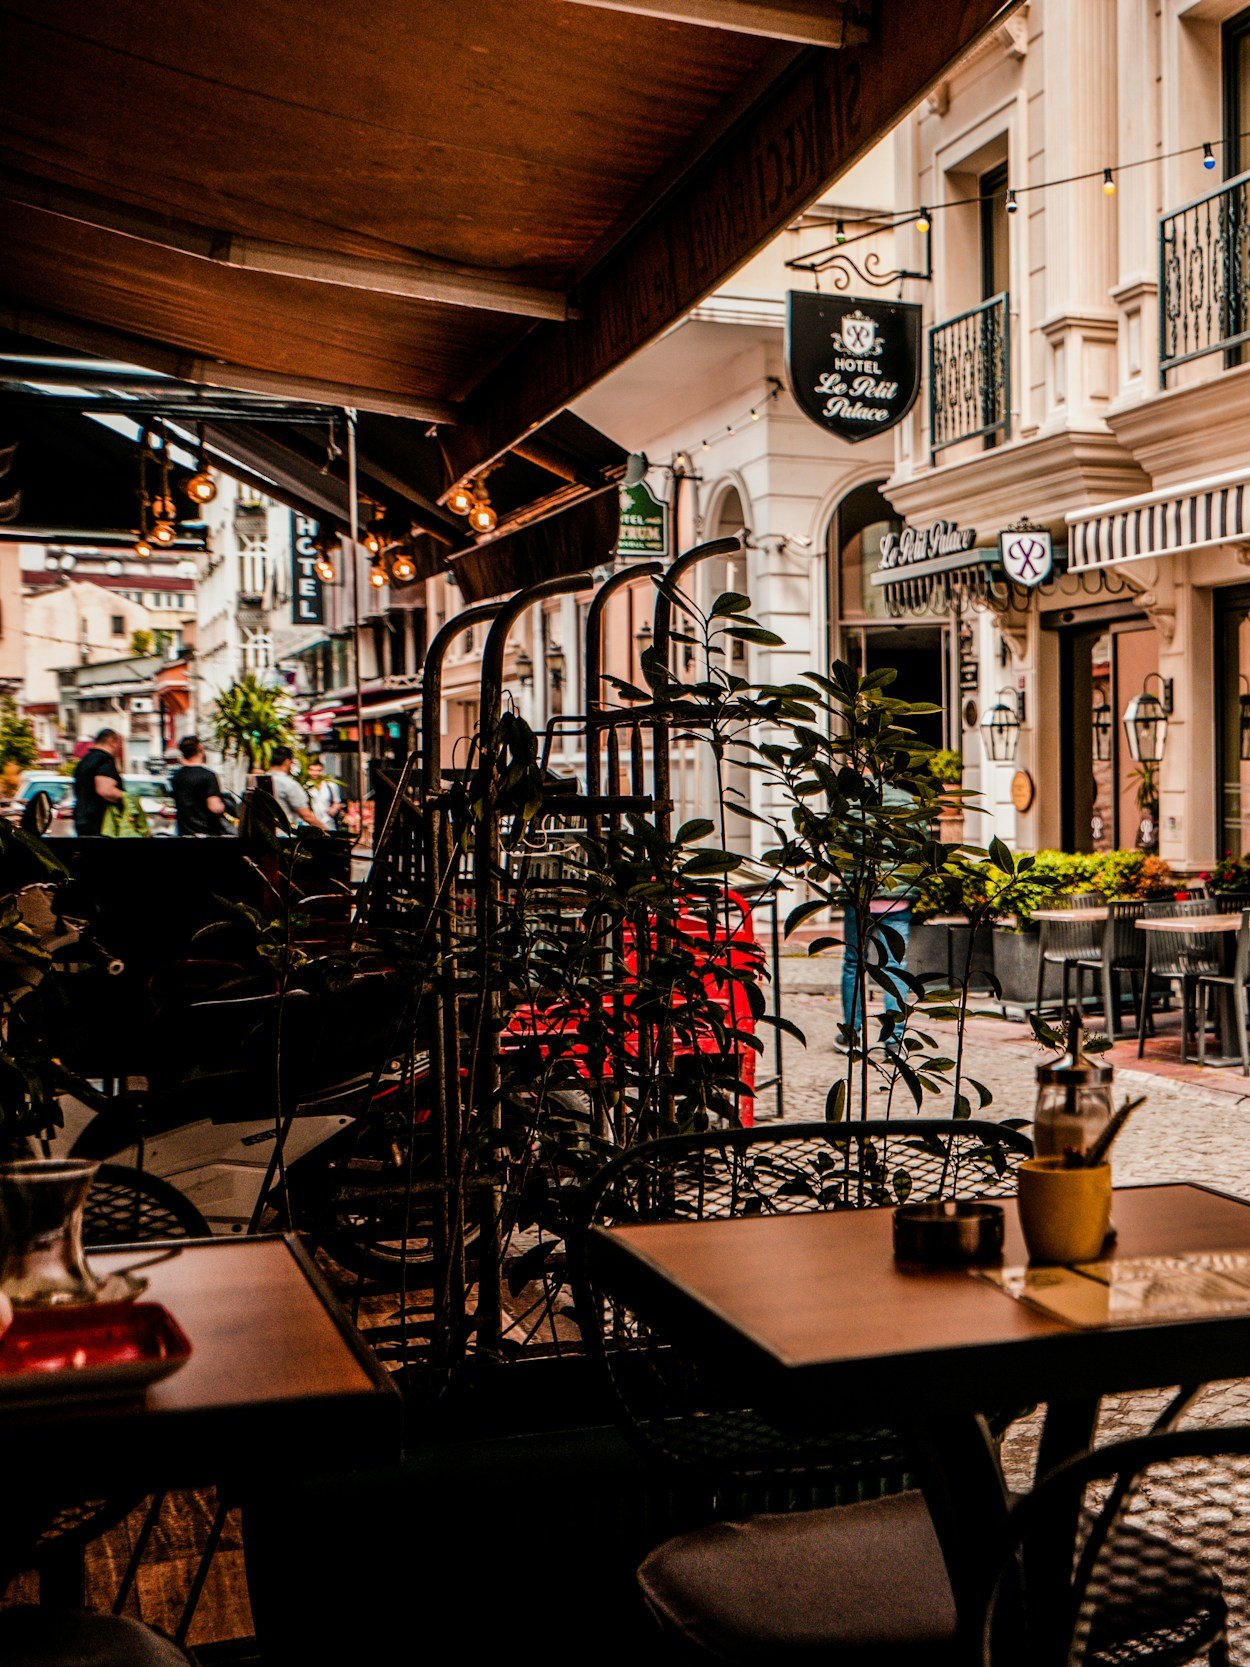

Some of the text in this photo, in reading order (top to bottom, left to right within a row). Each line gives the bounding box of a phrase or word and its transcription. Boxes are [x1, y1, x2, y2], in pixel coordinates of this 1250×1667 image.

[834, 357, 883, 375] HOTEL
[814, 373, 899, 400] Le Petit
[822, 396, 890, 422] Palace
[878, 532, 899, 569] Le
[928, 520, 976, 558] Palace
